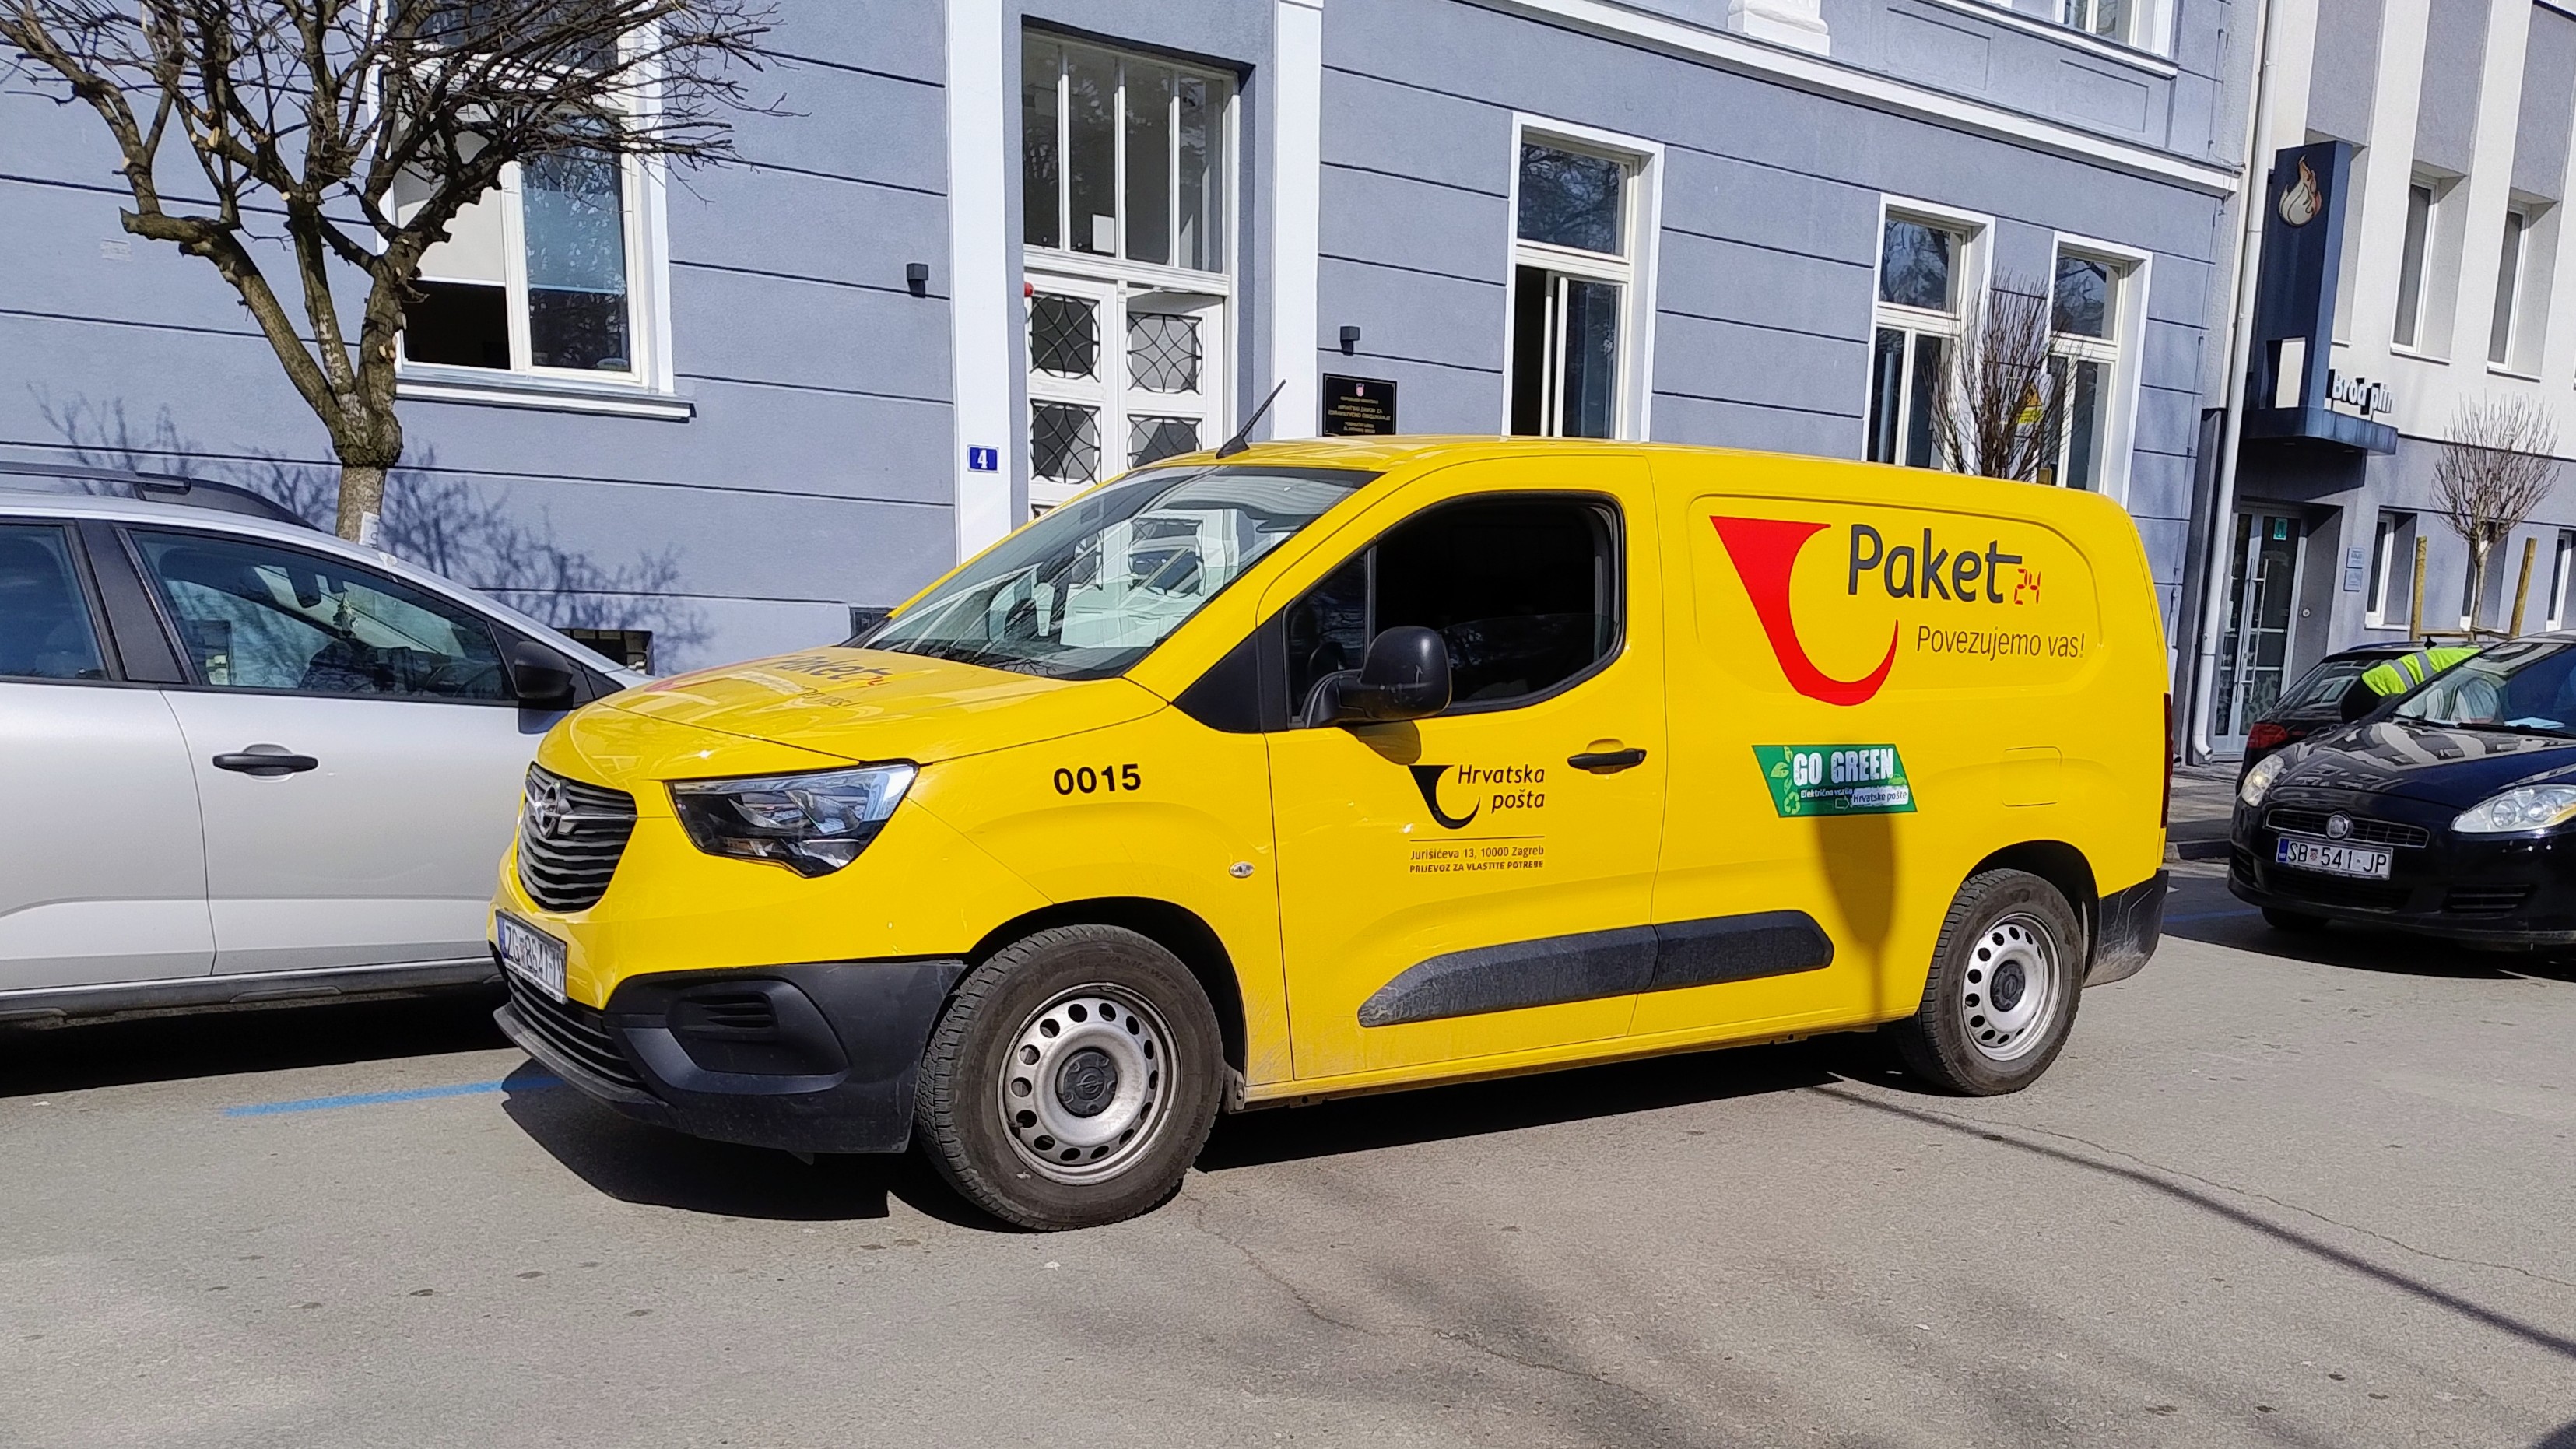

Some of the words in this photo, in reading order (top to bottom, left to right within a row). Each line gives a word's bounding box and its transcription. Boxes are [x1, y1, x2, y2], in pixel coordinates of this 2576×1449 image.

[2332, 369, 2367, 406] Brod
[977, 449, 988, 469] 4
[1847, 523, 2023, 604] Paket
[2013, 568, 2041, 605] 24
[1916, 625, 2041, 661] Povezujemo
[2048, 633, 2085, 658] vas!
[1053, 763, 1142, 795] 0015
[1458, 763, 1546, 784] Hrvatska
[1793, 752, 1823, 787] GO
[1830, 747, 1894, 784] GREEN
[1490, 788, 1546, 815] pošta
[1409, 864, 1451, 873] PRIJEVOZ
[1453, 863, 1465, 872] ZA
[1466, 861, 1504, 871] VLASTITE
[1507, 860, 1544, 869] POTREBE
[1463, 848, 1477, 859] 13,
[1480, 847, 1509, 858] 10000
[1511, 845, 1544, 858] Zagreb
[2287, 842, 2308, 862] SB
[2320, 847, 2387, 874] 541-JP
